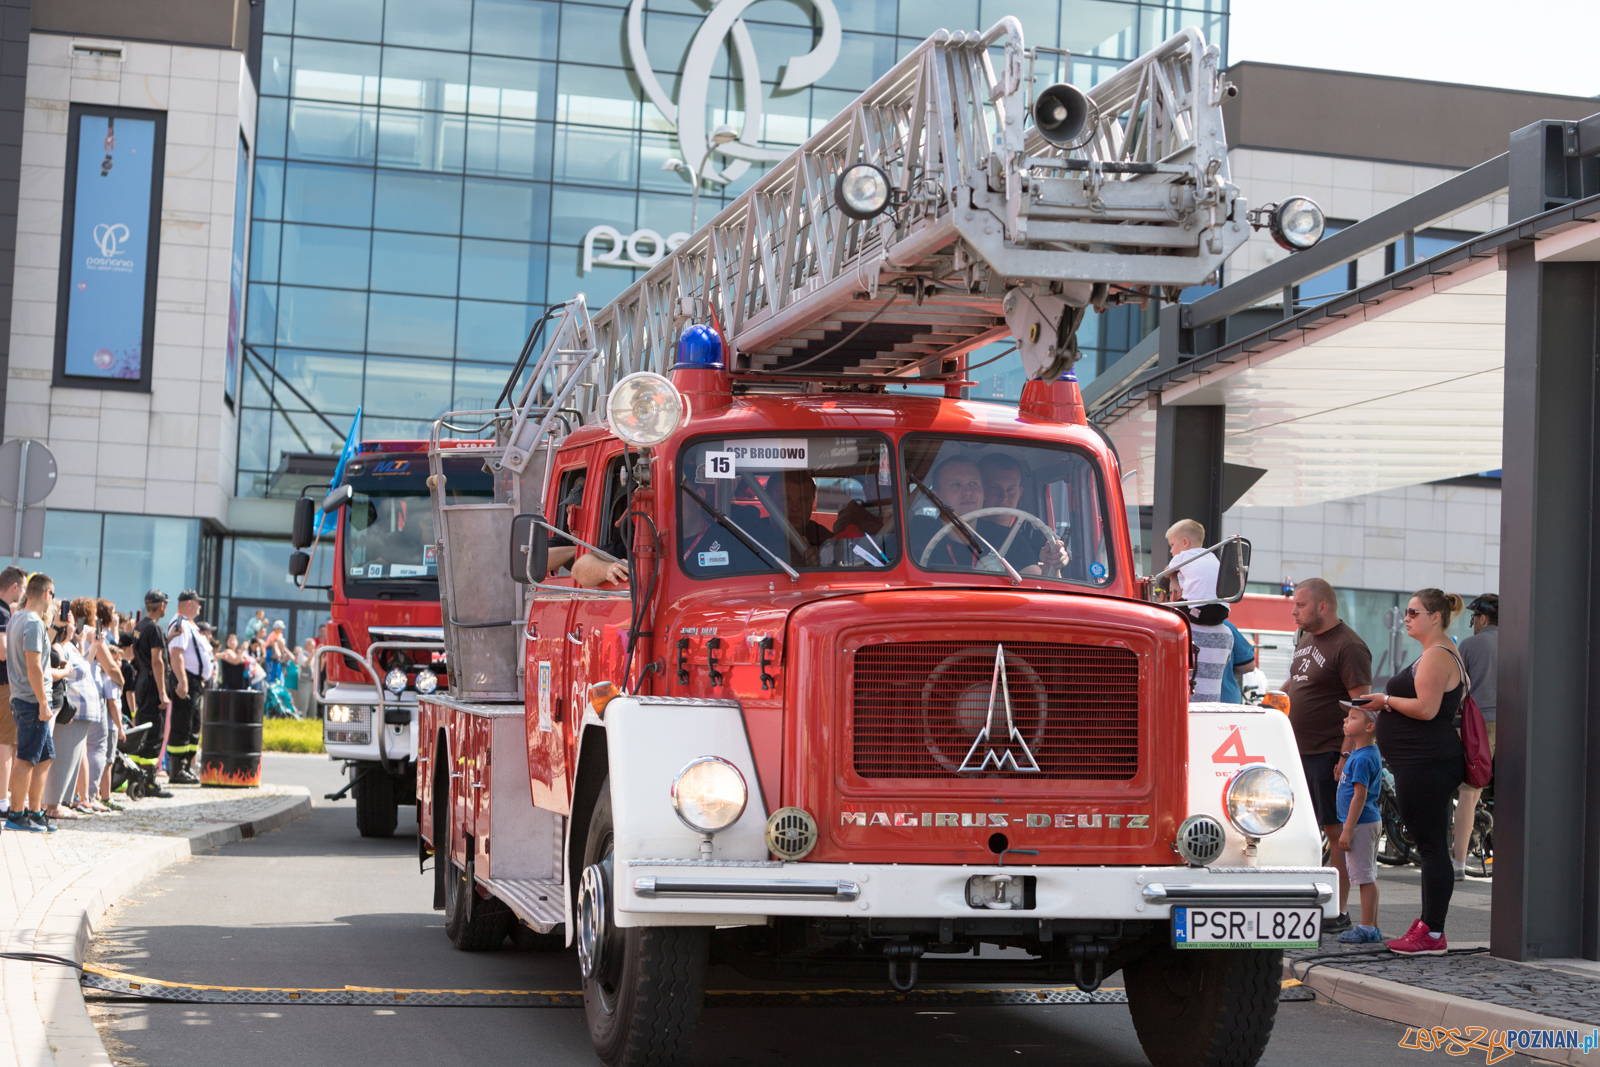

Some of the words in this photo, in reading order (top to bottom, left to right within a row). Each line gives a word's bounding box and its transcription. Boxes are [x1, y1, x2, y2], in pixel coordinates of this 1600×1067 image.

[750, 447, 805, 460] BRODOWO
[711, 457, 730, 473] 15
[370, 566, 380, 576] 50
[1298, 658, 1311, 673] 79
[840, 811, 1150, 829] MAGIRUS-DEUTZ
[1191, 911, 1246, 939] PSR
[1256, 911, 1317, 939] L826
[1176, 929, 1186, 937] PL
